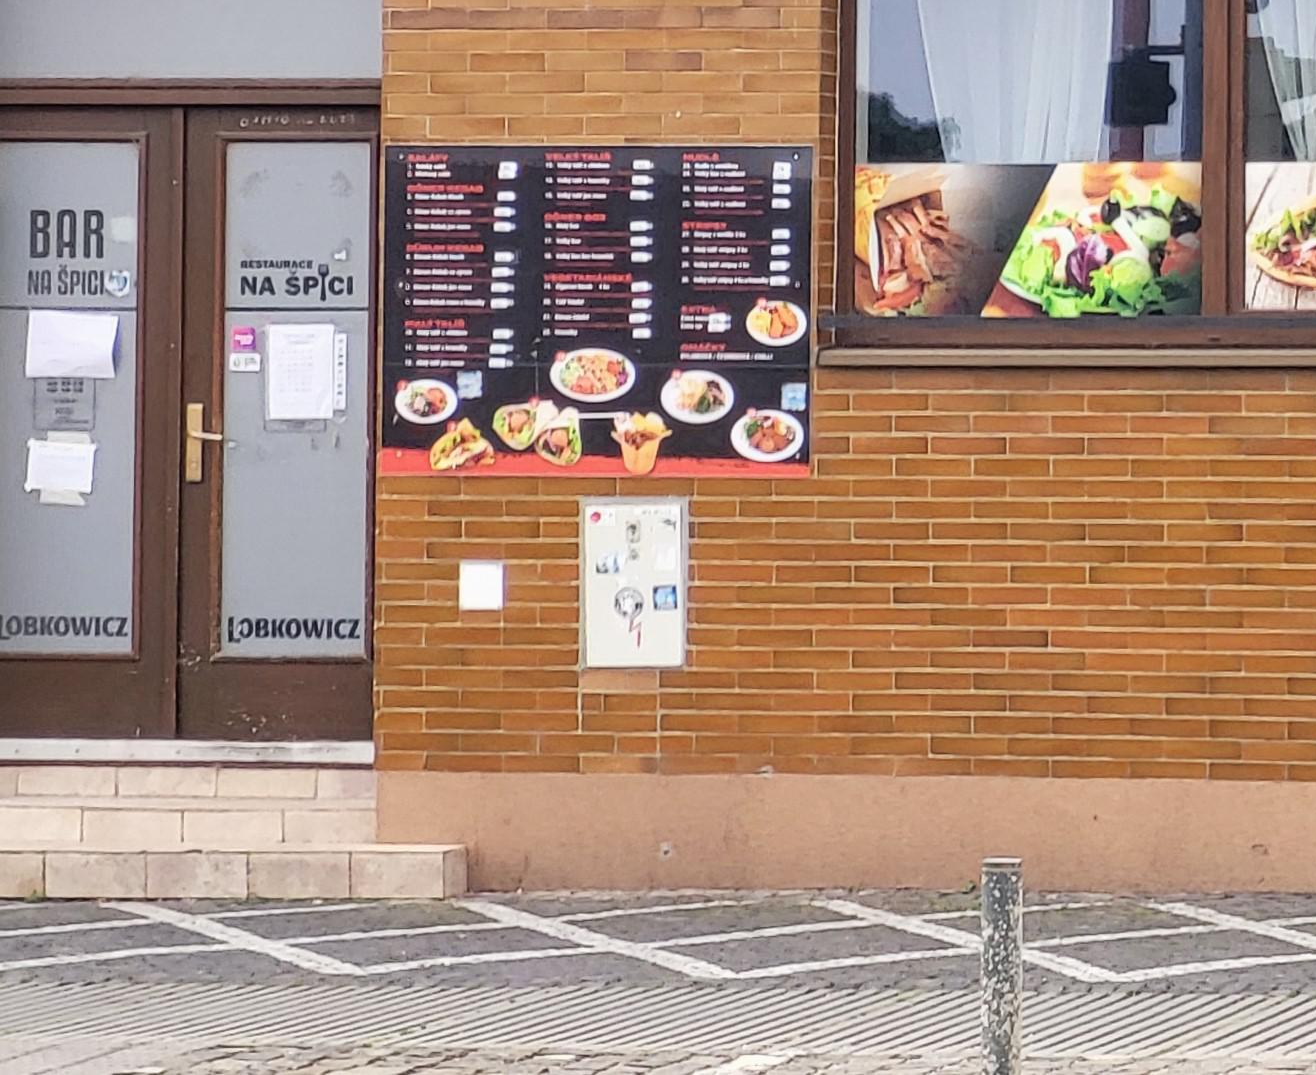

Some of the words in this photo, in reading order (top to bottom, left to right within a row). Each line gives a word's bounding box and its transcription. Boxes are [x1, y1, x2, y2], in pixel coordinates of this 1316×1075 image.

[29, 209, 105, 259] BAR
[239, 259, 314, 270] RESTAURACE
[27, 269, 52, 295] NA
[57, 264, 105, 296] ŠPICI
[239, 275, 276, 296] NA
[227, 615, 362, 643] LOBKOWICZ
